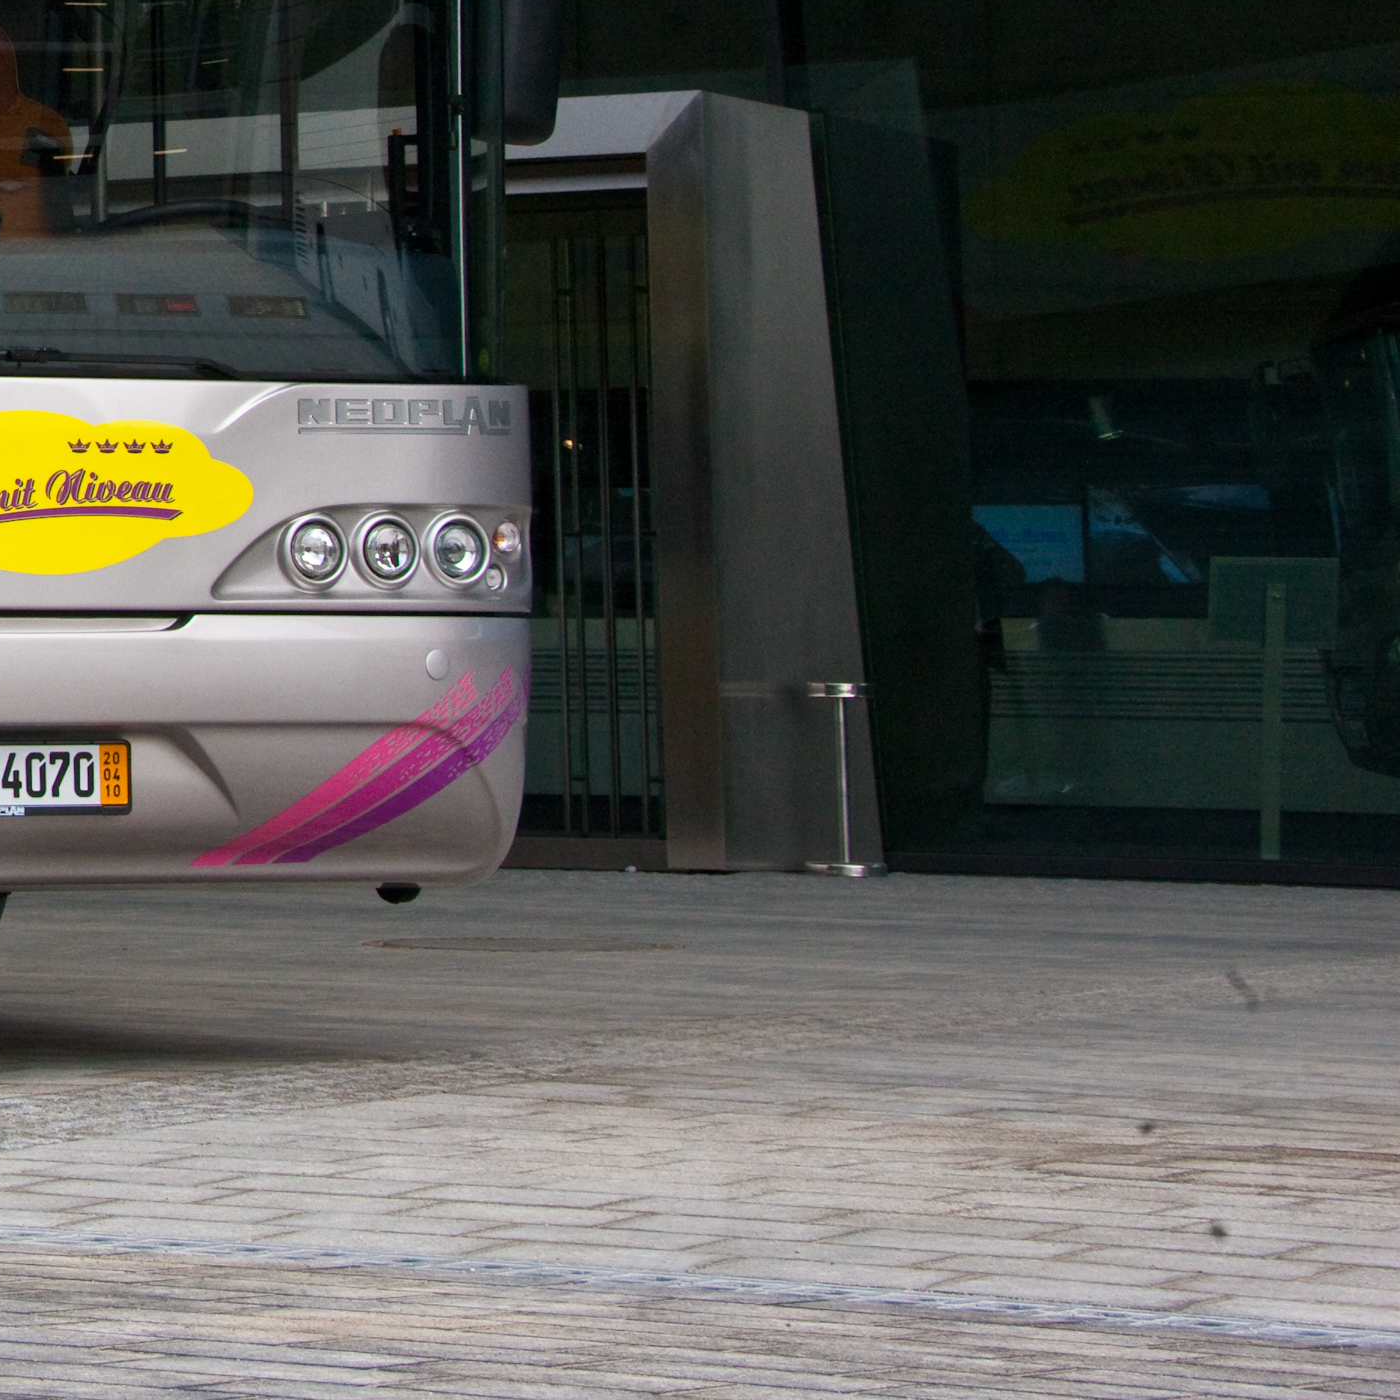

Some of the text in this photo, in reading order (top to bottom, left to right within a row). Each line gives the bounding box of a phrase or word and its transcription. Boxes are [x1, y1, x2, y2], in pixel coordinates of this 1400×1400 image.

[297, 396, 512, 435] NEOPLAN
[45, 468, 175, 505] Niveau
[103, 751, 120, 765] 20
[103, 768, 120, 781] 04
[104, 784, 121, 797] 10
